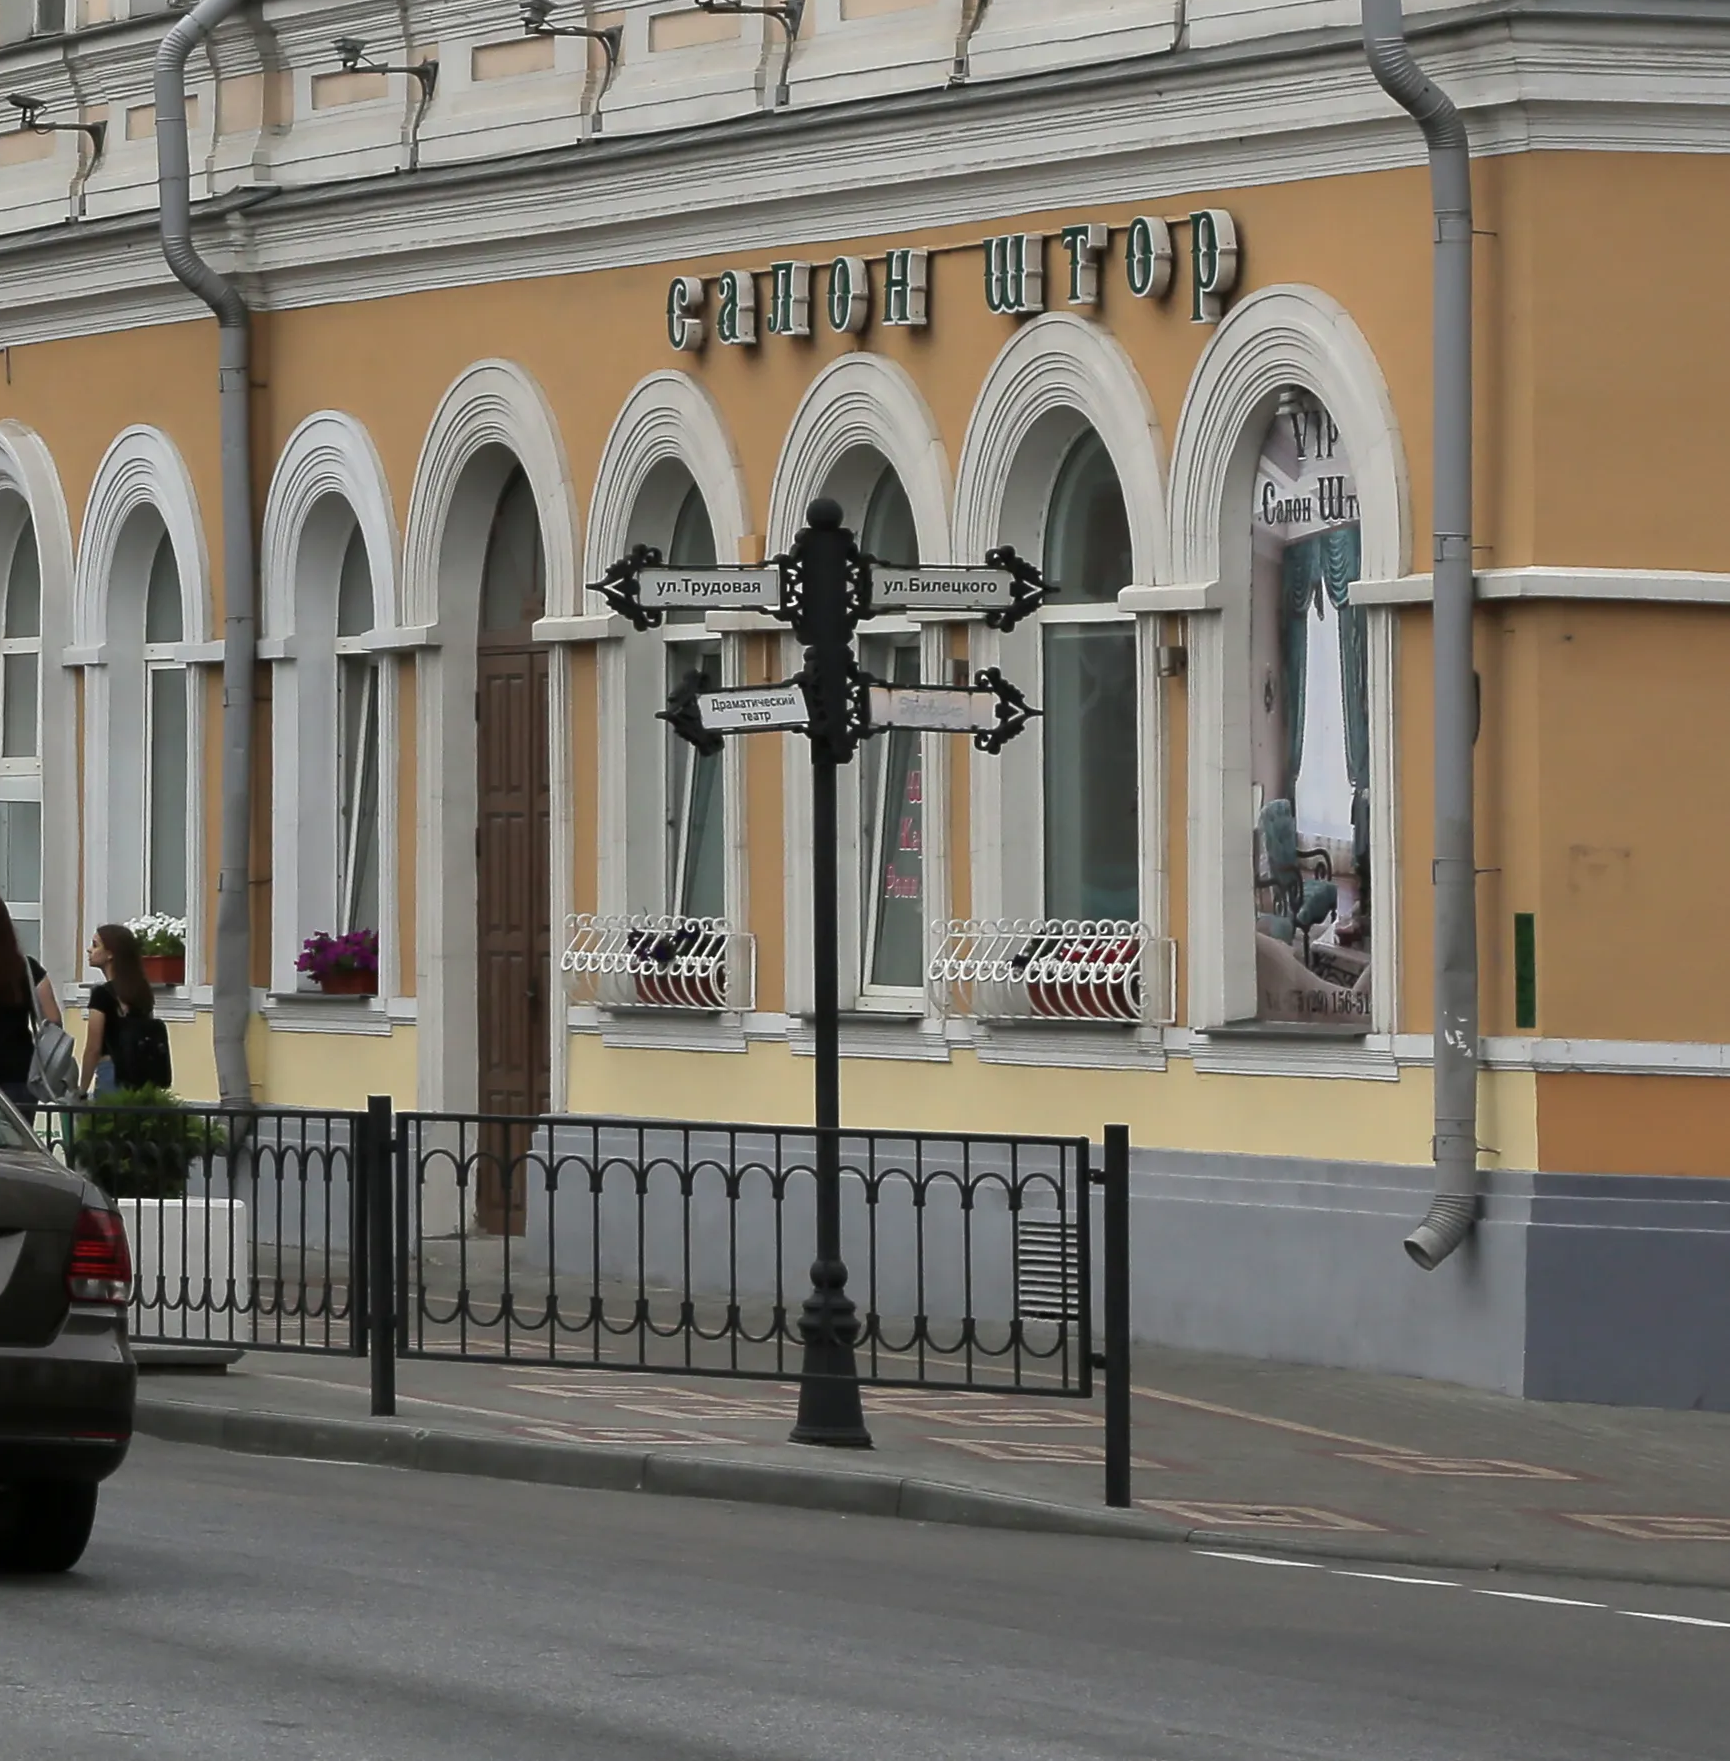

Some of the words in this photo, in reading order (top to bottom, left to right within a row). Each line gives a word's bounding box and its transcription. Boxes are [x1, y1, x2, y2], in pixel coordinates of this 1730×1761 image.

[1262, 480, 1312, 526] Салон
[656, 578, 762, 597] ул.Трудовая
[883, 578, 998, 595] ул.Билецкого
[710, 694, 796, 713] Драматический
[740, 709, 772, 723] театр
